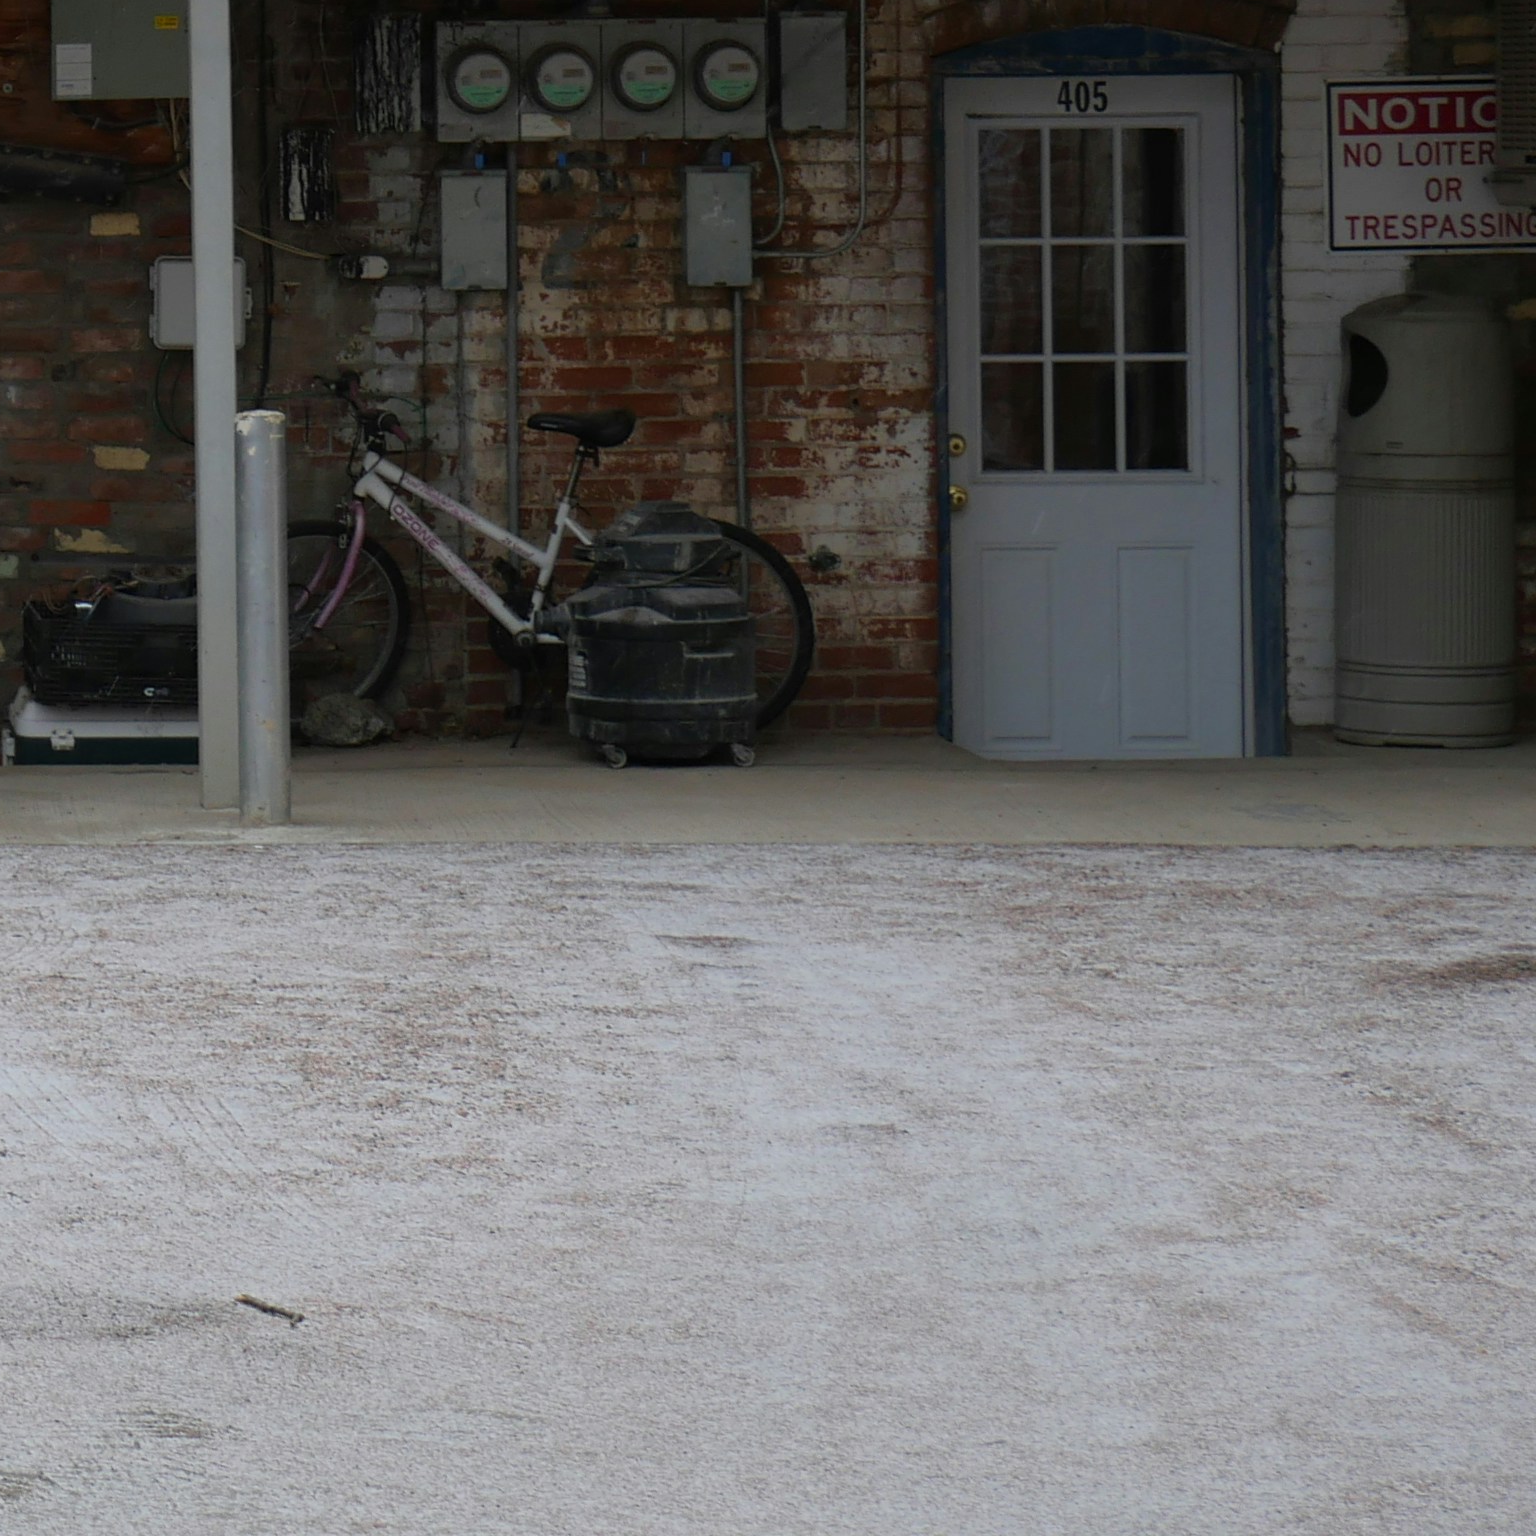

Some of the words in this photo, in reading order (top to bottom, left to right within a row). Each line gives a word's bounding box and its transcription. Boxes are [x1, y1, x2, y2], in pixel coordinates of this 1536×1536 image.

[1057, 80, 1108, 113] 405
[1343, 95, 1497, 131] NOTIC
[1343, 142, 1382, 167] NO
[1397, 140, 1496, 167] LOITER
[1424, 177, 1463, 203] OR
[1345, 211, 1536, 241] TRESPASSING
[392, 503, 440, 551] OZONE
